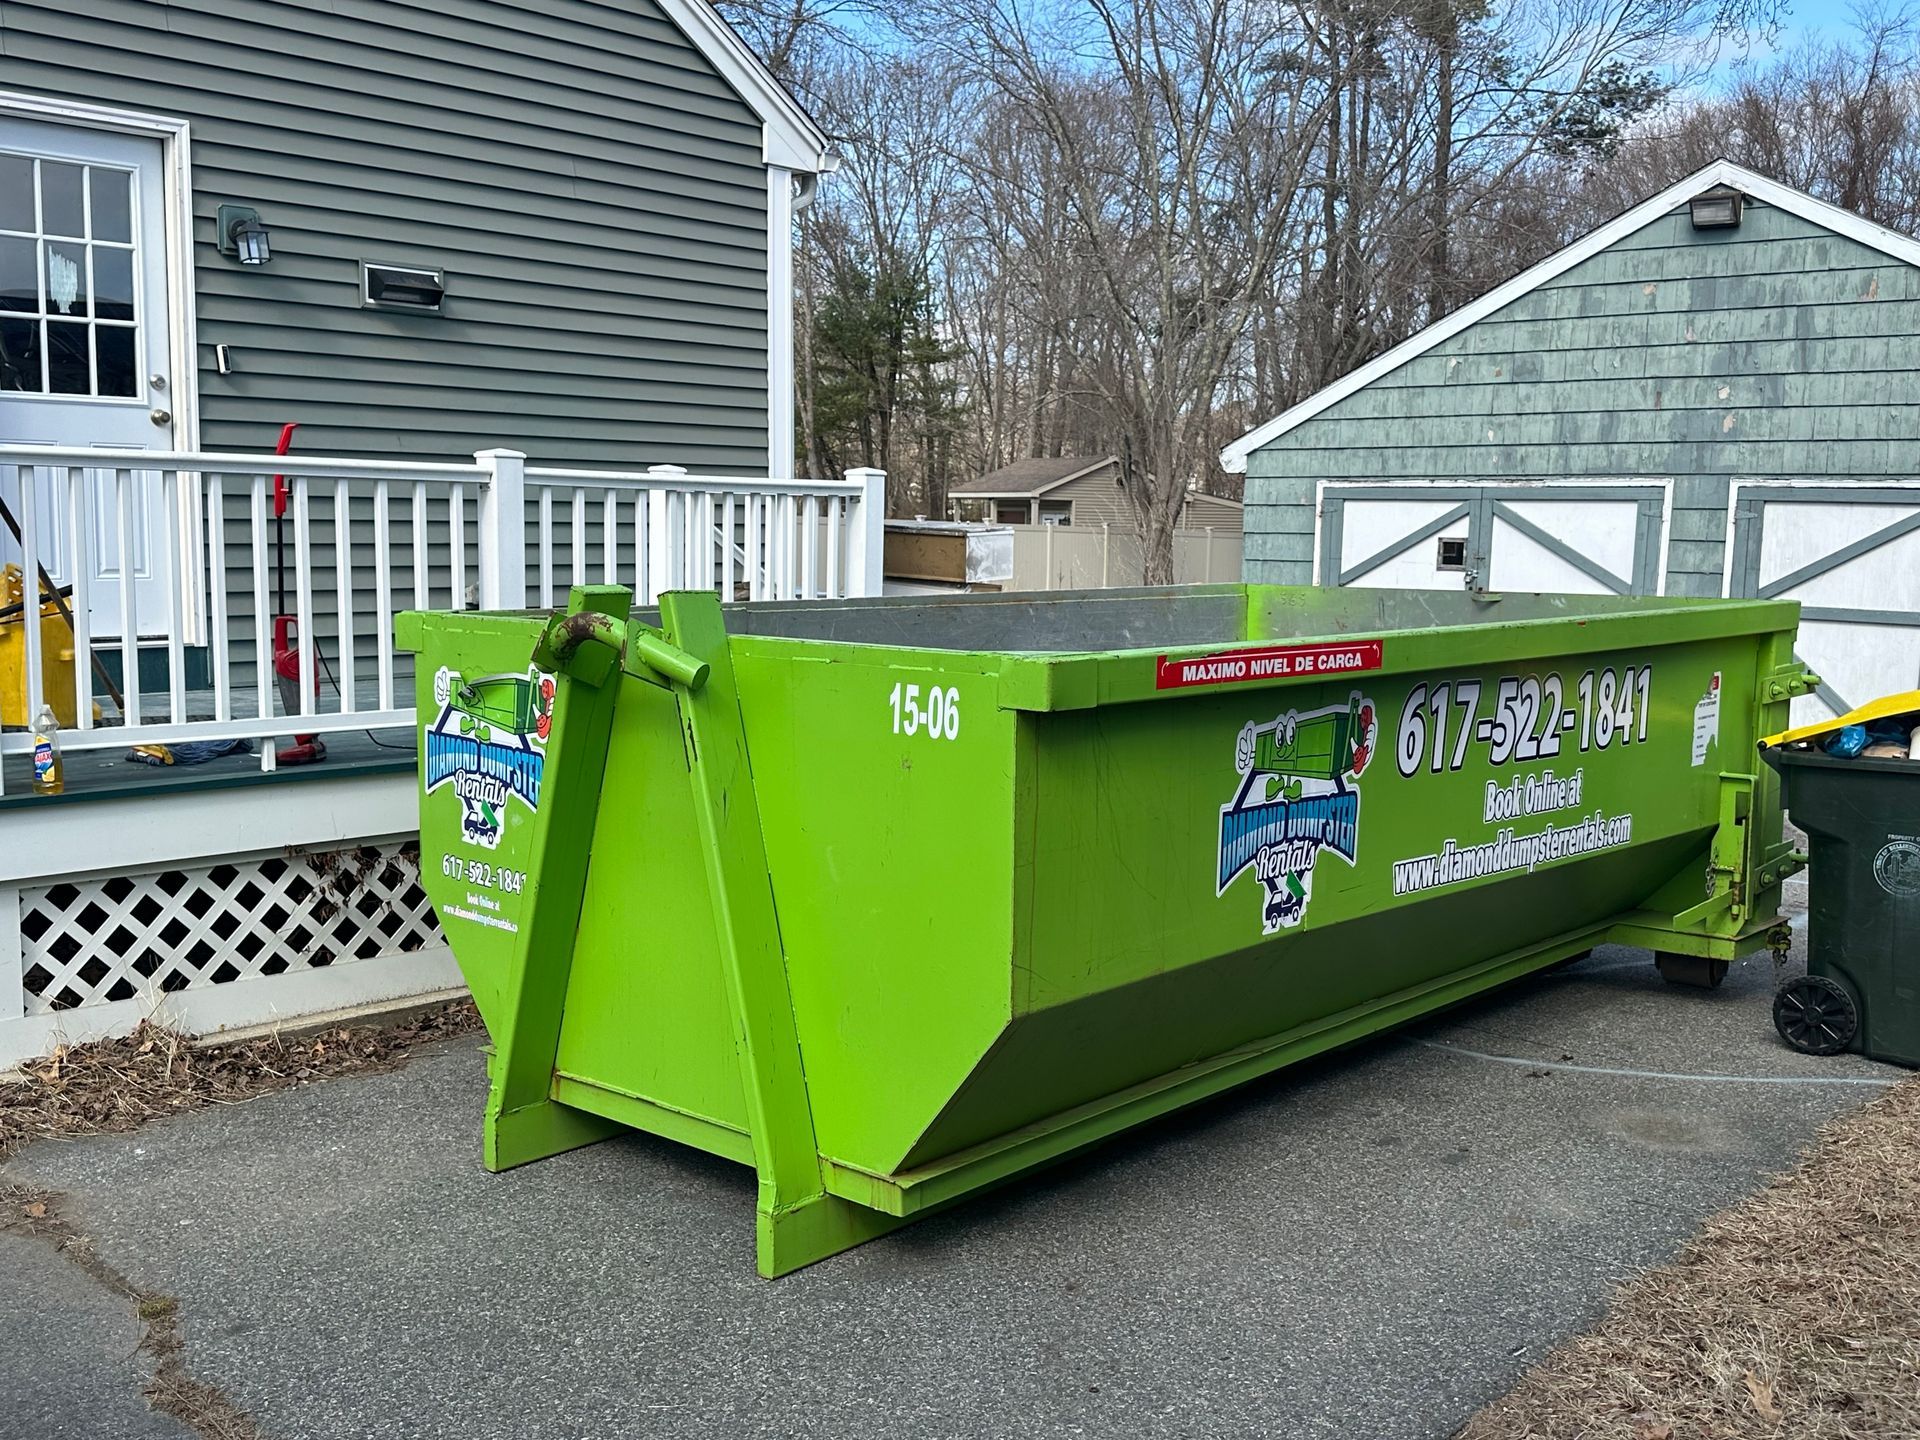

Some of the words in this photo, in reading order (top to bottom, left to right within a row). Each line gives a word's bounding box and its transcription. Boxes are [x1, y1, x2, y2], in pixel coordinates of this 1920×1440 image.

[1183, 660, 1246, 682] MAXIMO
[1250, 658, 1291, 676] NIVEL
[1295, 656, 1314, 672] DE
[1318, 652, 1363, 671] CARGA
[889, 682, 960, 741] 15-06
[1397, 665, 1652, 778] 617-522-1841
[428, 732, 478, 785] DIAMOND
[1485, 776, 1522, 823] Book
[1524, 771, 1566, 816] Online
[1567, 769, 1583, 807] at
[1223, 803, 1286, 883] DIAMOND
[1287, 794, 1357, 855] DUMPSTER
[1394, 813, 1632, 895] www.diamonddumpsterrentals.com
